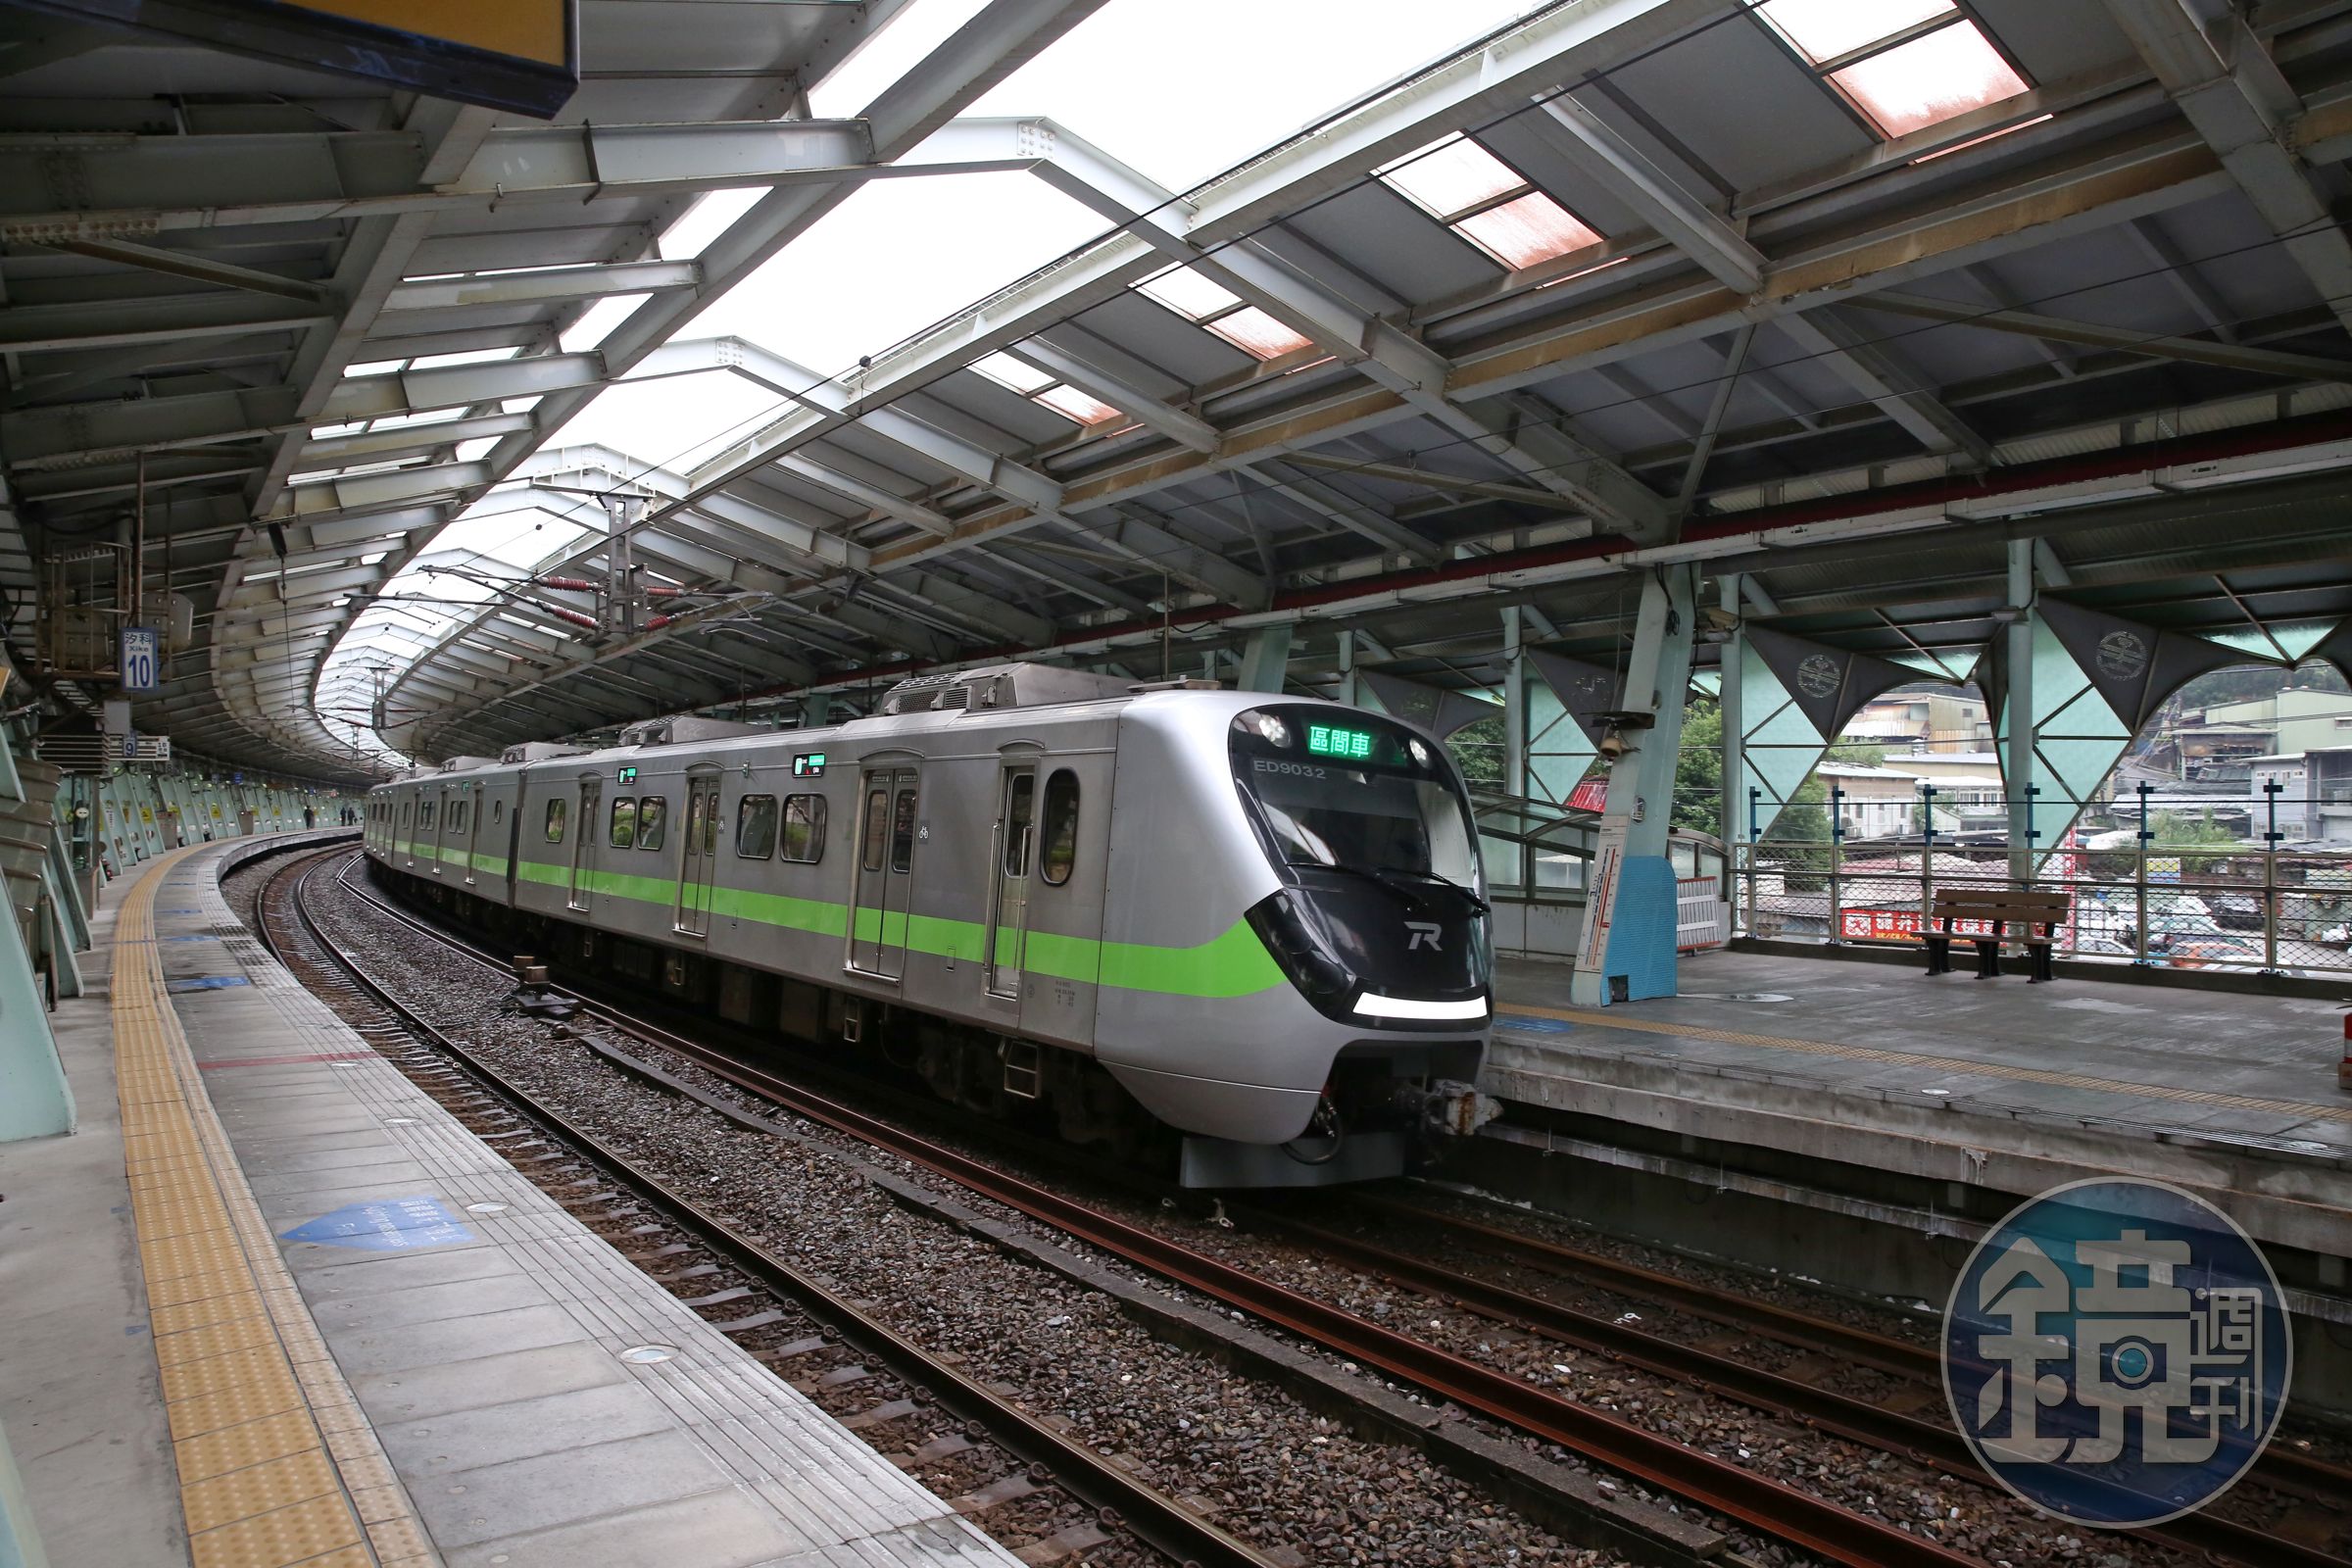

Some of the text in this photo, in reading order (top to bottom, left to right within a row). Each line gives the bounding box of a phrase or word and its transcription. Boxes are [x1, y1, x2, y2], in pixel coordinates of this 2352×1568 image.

[124, 633, 152, 645] 汐科
[128, 655, 150, 687] 10
[125, 742, 134, 757] 9
[1310, 726, 1370, 758] 區間車
[1253, 760, 1326, 779] ED9032
